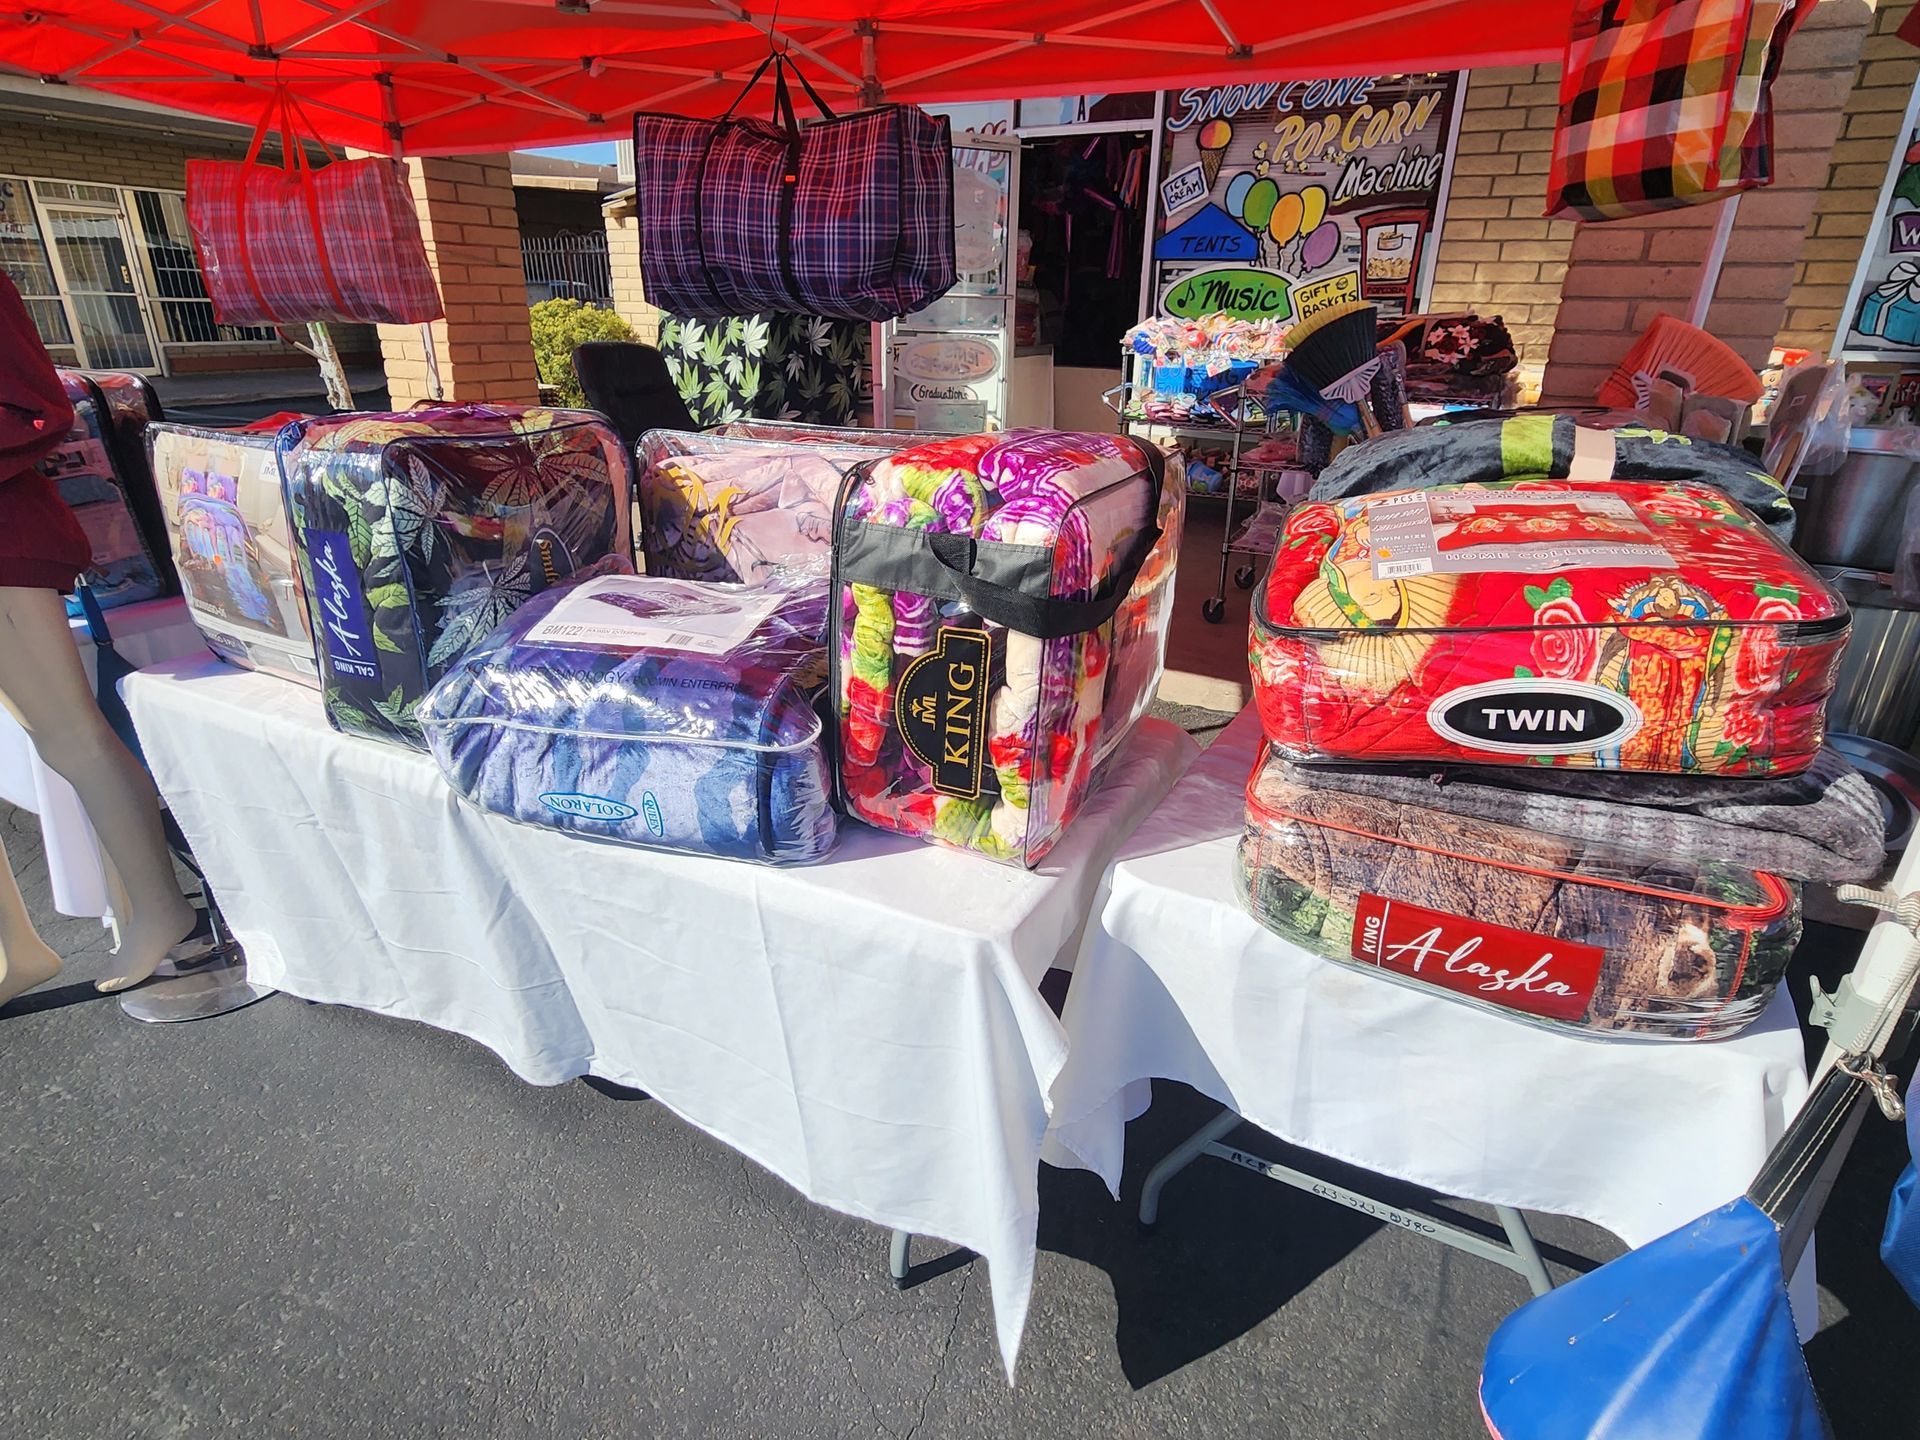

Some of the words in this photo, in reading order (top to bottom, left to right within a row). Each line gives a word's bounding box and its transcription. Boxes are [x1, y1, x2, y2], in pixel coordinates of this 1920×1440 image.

[1166, 82, 1280, 132] SNOW
[1277, 76, 1383, 113] CONE
[1169, 176, 1189, 192] ICE
[1333, 144, 1443, 200] Machine
[1168, 179, 1202, 205] CREAM
[1180, 234, 1242, 253] TENTS
[1201, 279, 1281, 312] Music
[1300, 283, 1331, 303] GIFT
[1302, 289, 1358, 320] BASKETS
[1393, 493, 1413, 504] PCS
[1445, 551, 1510, 562] HOME
[1518, 549, 1667, 562] COLLECTION
[315, 540, 362, 657] Alaska
[541, 625, 583, 636] BM122
[334, 660, 355, 674] KING
[355, 664, 375, 677] CAL
[943, 661, 976, 769] KING
[1481, 708, 1586, 732] TWIN
[549, 796, 625, 816] SOLARON
[644, 799, 661, 830] QUEEN
[1361, 914, 1381, 955] KING
[1385, 926, 1579, 997] Alaska
